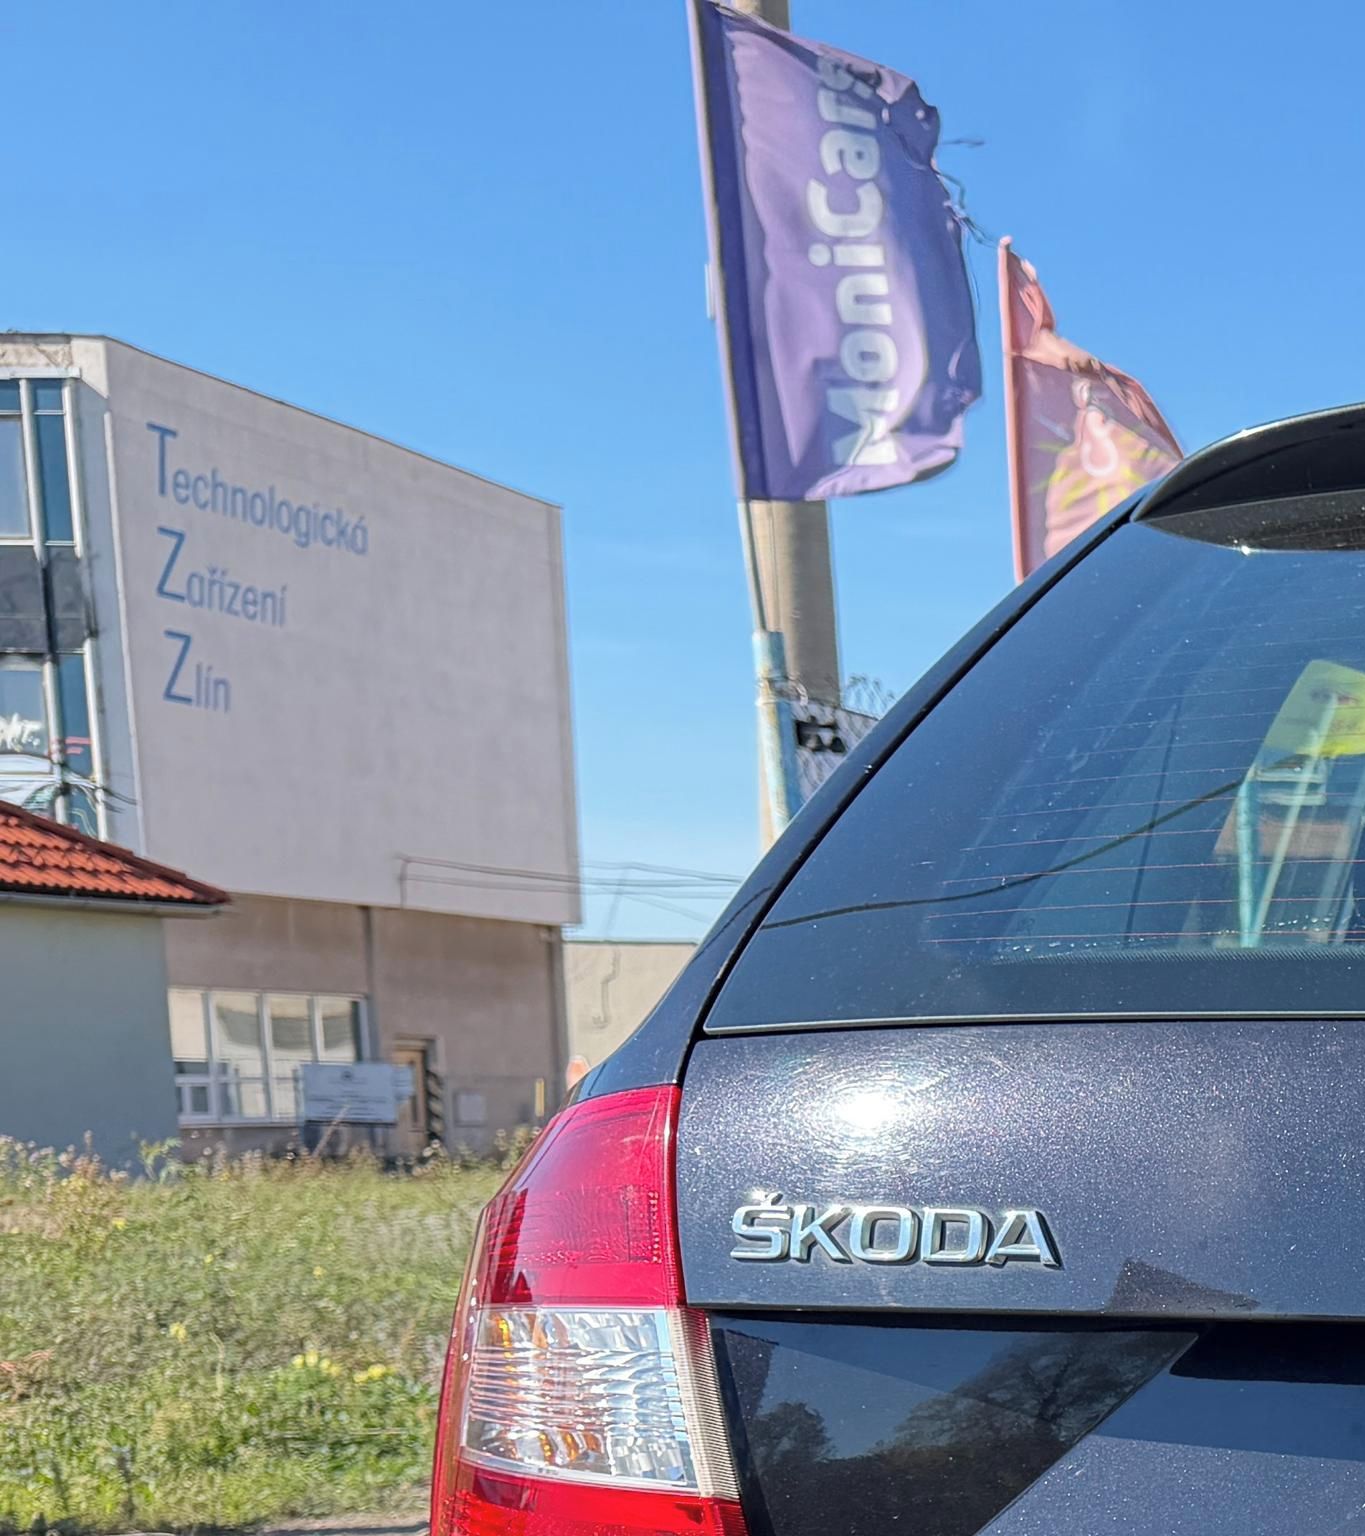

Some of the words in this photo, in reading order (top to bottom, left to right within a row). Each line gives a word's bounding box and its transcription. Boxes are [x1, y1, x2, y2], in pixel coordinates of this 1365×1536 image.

[146, 421, 369, 557] Technologická
[157, 525, 288, 628] Zařízení
[163, 629, 232, 713] Zlín
[730, 1190, 1064, 1271] ŠKODA
